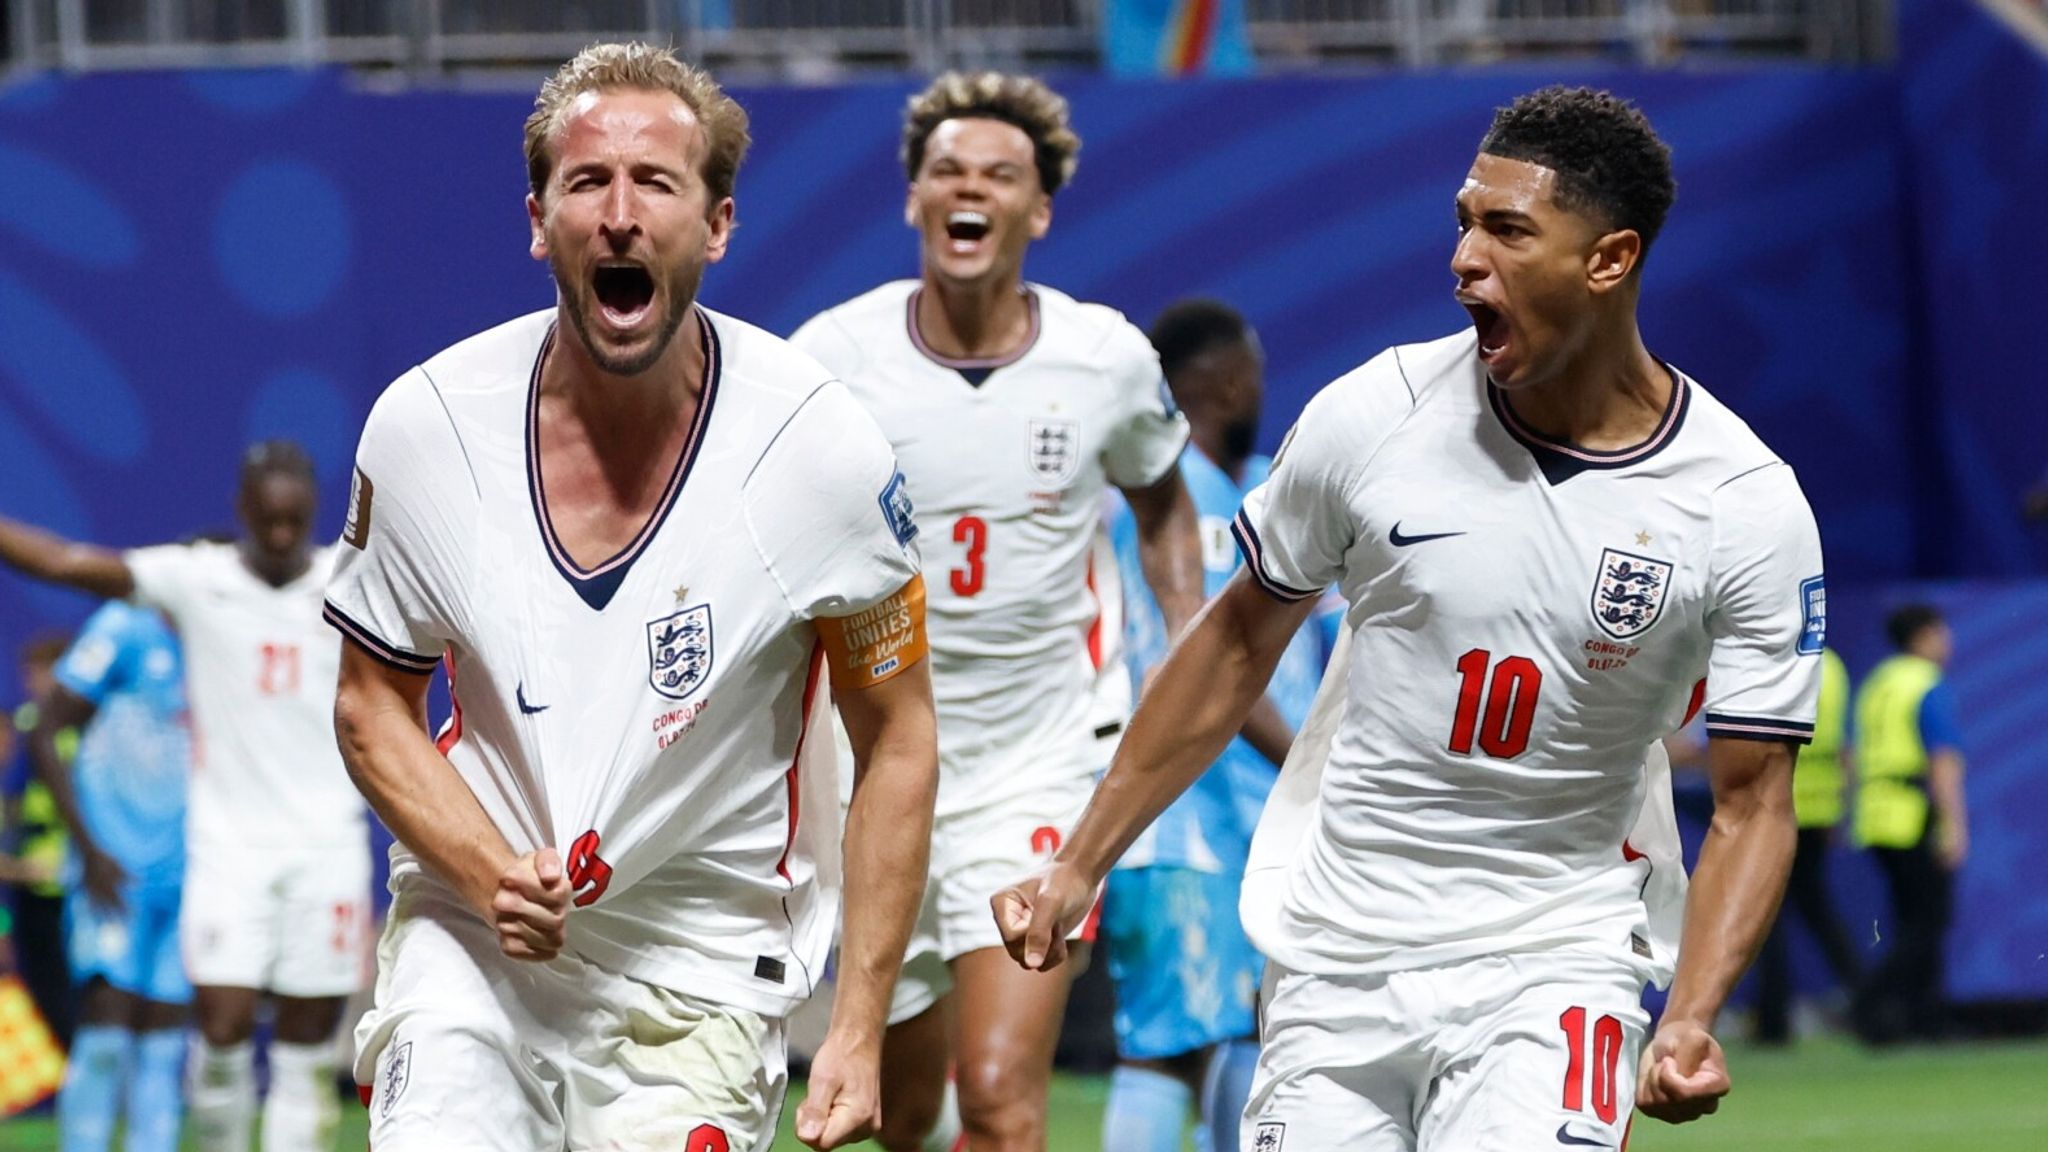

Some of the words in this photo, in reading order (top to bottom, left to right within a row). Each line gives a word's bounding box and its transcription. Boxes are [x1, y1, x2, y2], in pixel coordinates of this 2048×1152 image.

[950, 515, 987, 597] 3
[842, 595, 908, 632] FOOTBALL
[845, 608, 912, 650] UNITES
[875, 624, 914, 660] World
[1585, 640, 1625, 655] CONGO
[873, 659, 897, 676] FIFA
[652, 708, 692, 732] CONGO
[1448, 648, 1543, 759] 10
[1559, 1005, 1624, 1126] 10
